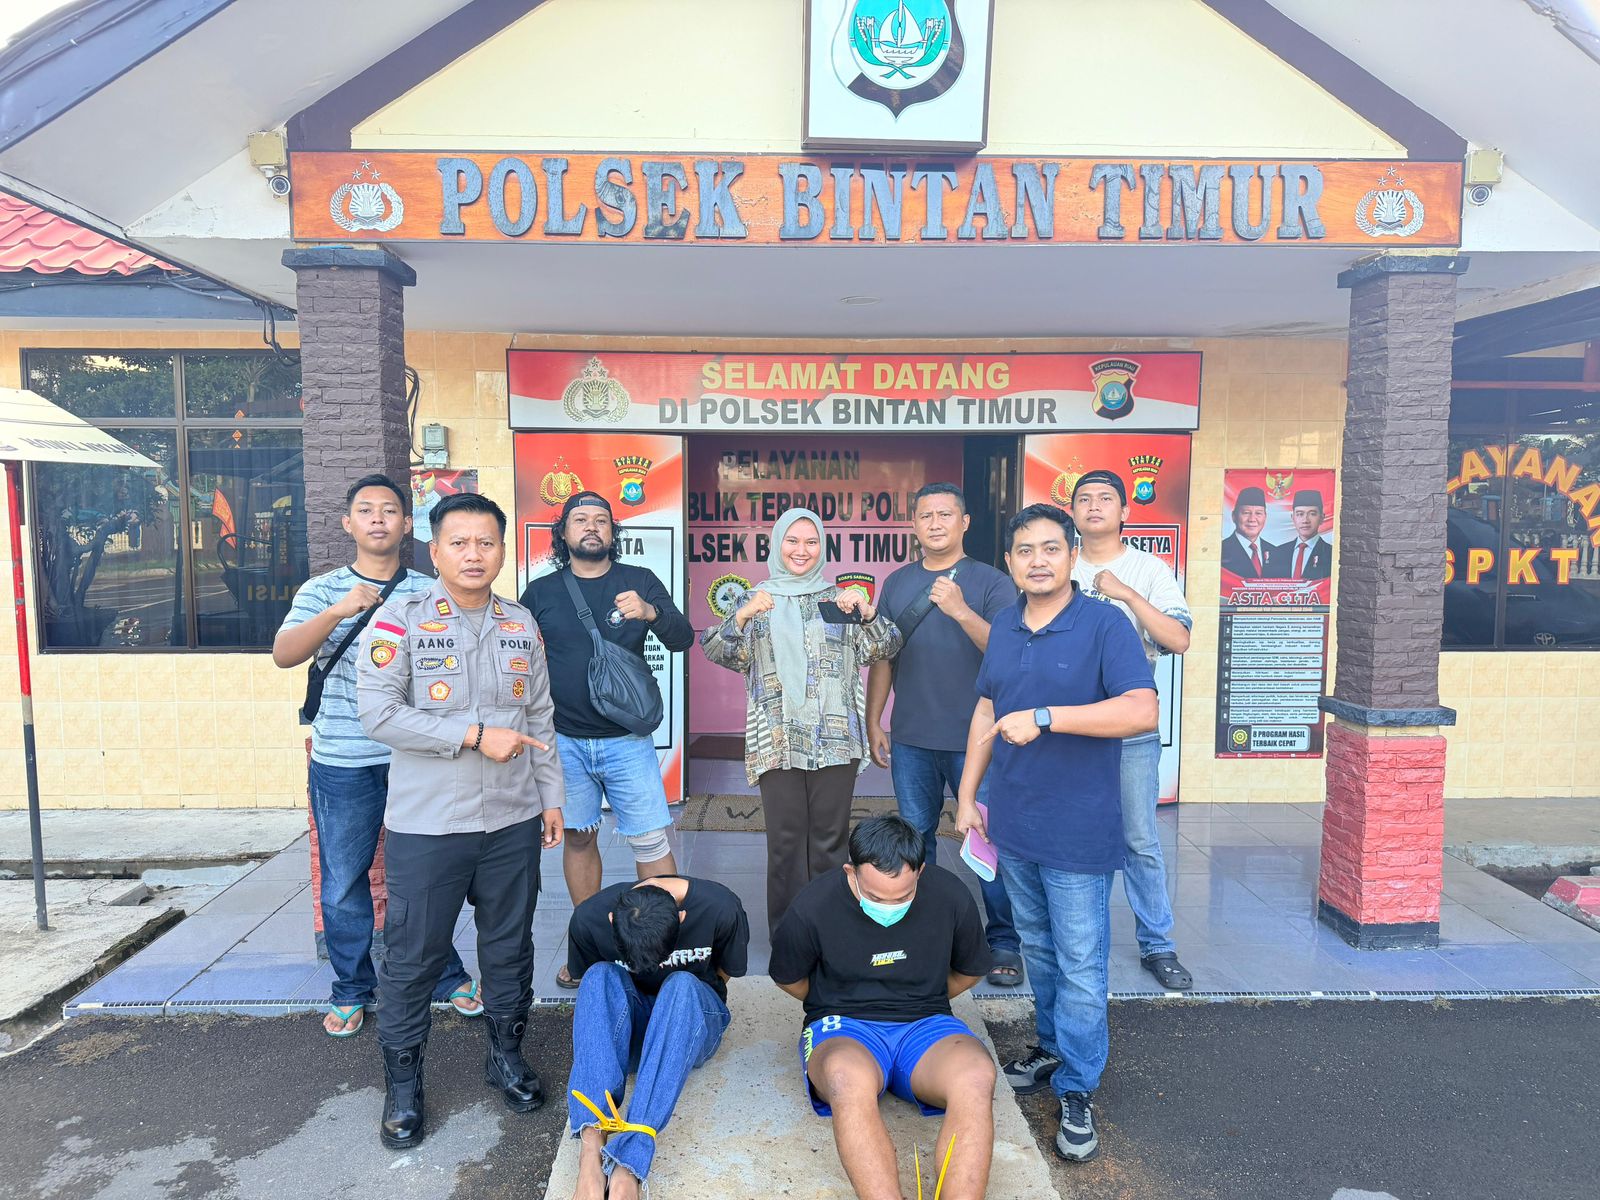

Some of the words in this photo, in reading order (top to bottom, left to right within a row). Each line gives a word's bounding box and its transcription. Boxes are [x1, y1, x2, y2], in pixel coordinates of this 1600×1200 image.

[436, 156, 746, 239] POLSEK
[778, 159, 1060, 241] BINTAN
[1089, 162, 1326, 241] TIMUR
[701, 362, 862, 392] SELAMAT
[871, 362, 1010, 391] DATANG
[658, 398, 688, 424] DI
[701, 398, 822, 425] POLSEK
[831, 398, 954, 425] BINTAN
[957, 398, 1058, 425] TIMUR
[721, 450, 860, 481] PELAYANAN
[688, 491, 740, 522] BLIK
[1446, 443, 1600, 548] AYANA
[688, 533, 749, 563] LSEK
[849, 533, 924, 563] TIMUR
[1121, 535, 1172, 554] ASETYA
[1227, 591, 1273, 606] ASTA
[1277, 591, 1321, 606] CITA
[417, 638, 455, 649] AANG
[500, 639, 532, 651] POLRI
[1252, 730, 1258, 738] 8
[1258, 730, 1289, 738] PROGRAM
[1289, 730, 1306, 738] HASIL
